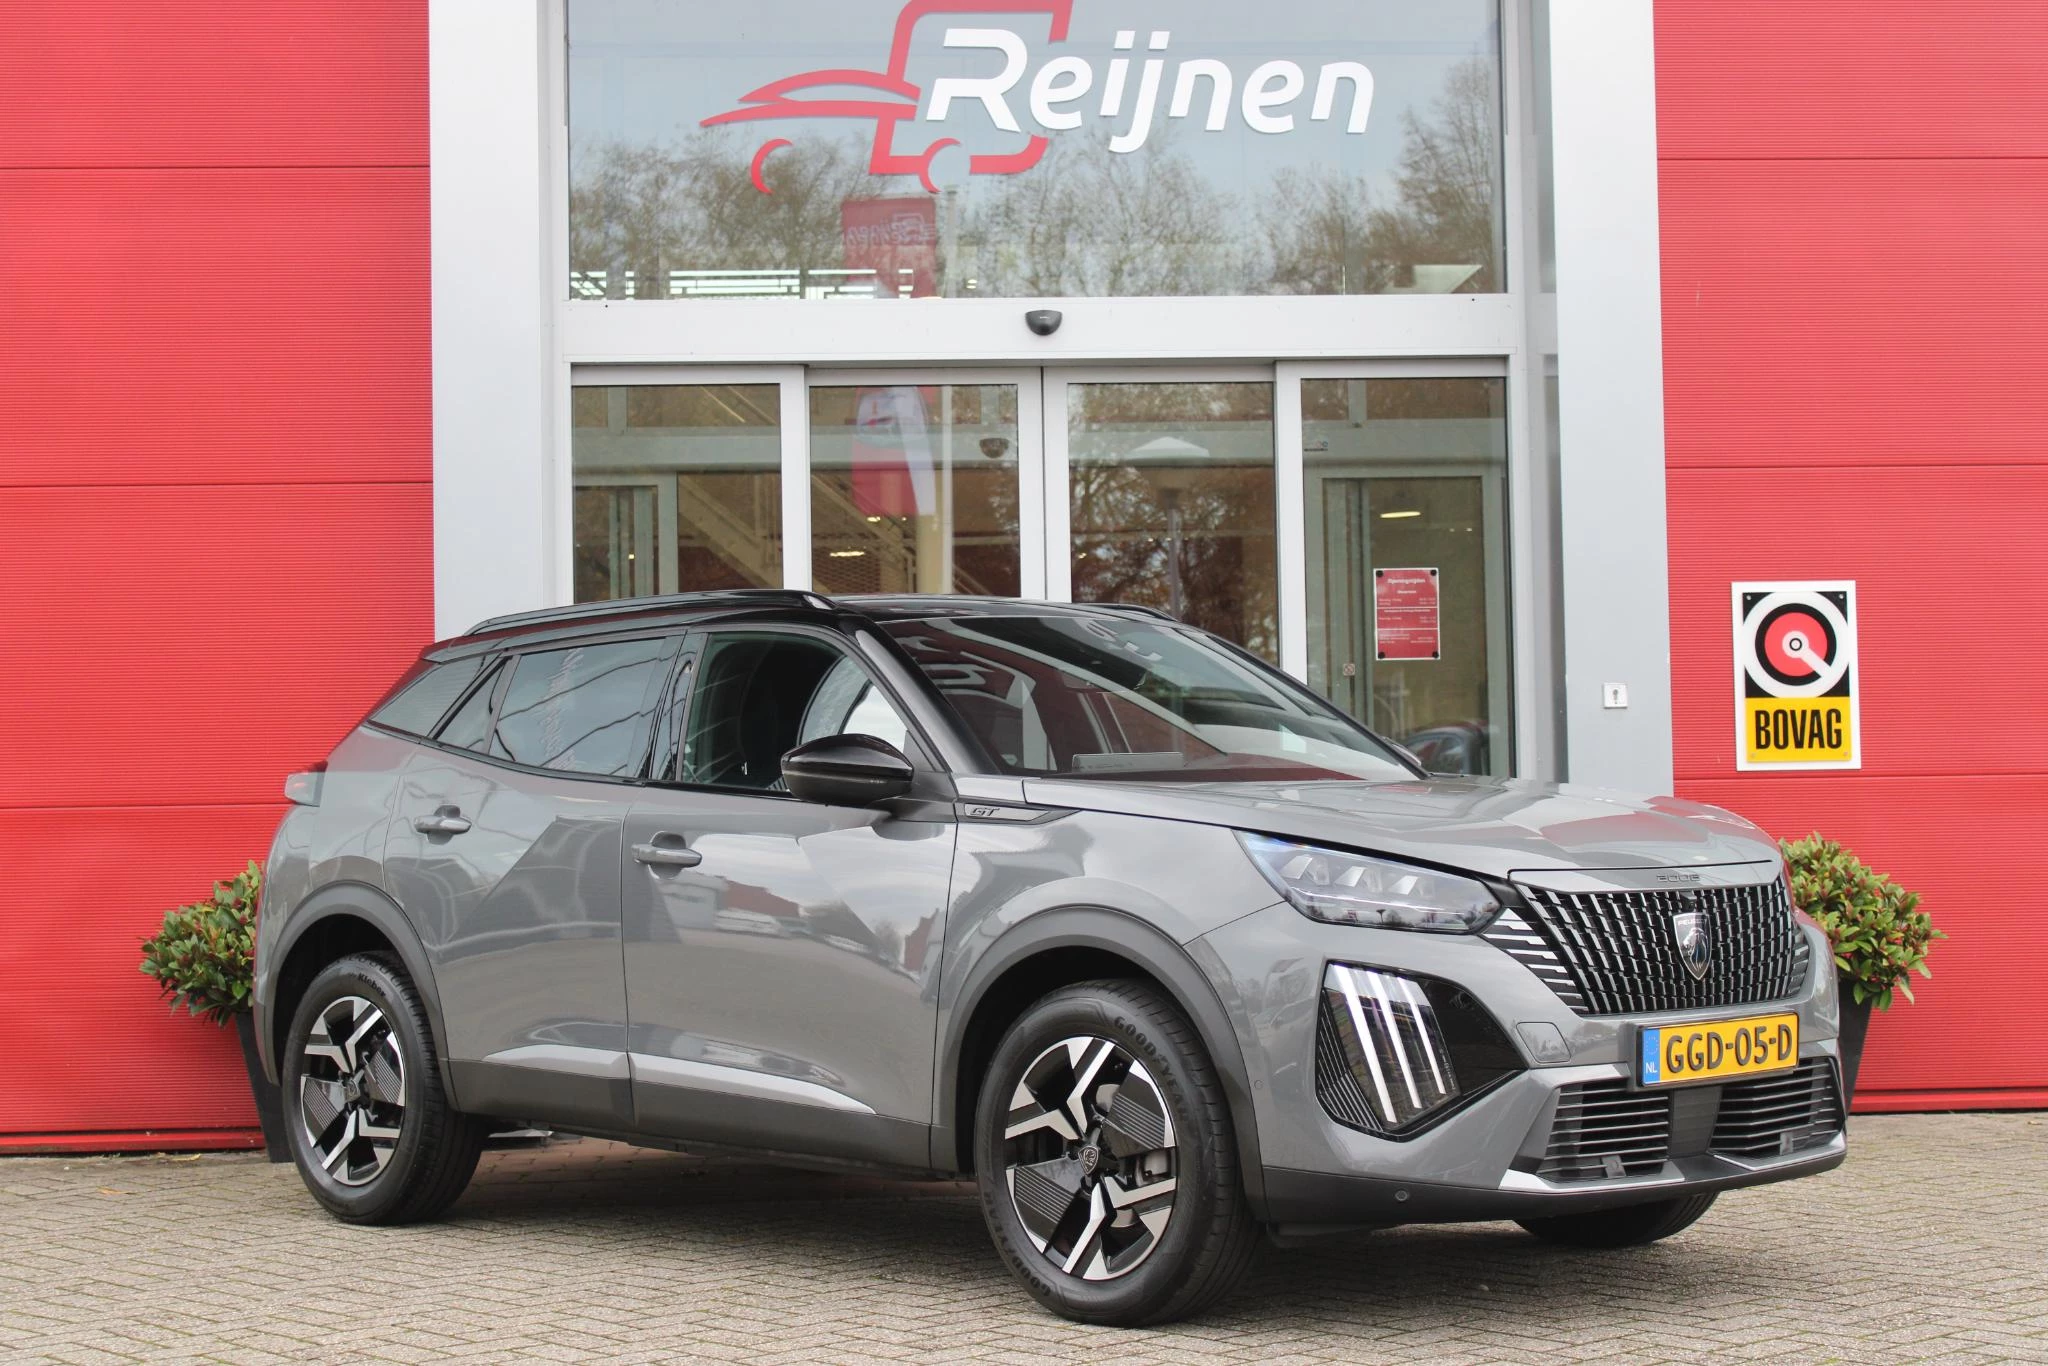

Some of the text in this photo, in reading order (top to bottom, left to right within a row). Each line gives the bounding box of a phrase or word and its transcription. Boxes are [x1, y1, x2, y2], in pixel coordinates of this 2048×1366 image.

[926, 28, 1375, 153] Reijnen
[1754, 708, 1843, 750] BOVAG
[971, 807, 1000, 817] GT
[1645, 1062, 1657, 1073] NL
[1666, 1024, 1792, 1073] GGD-05-D
